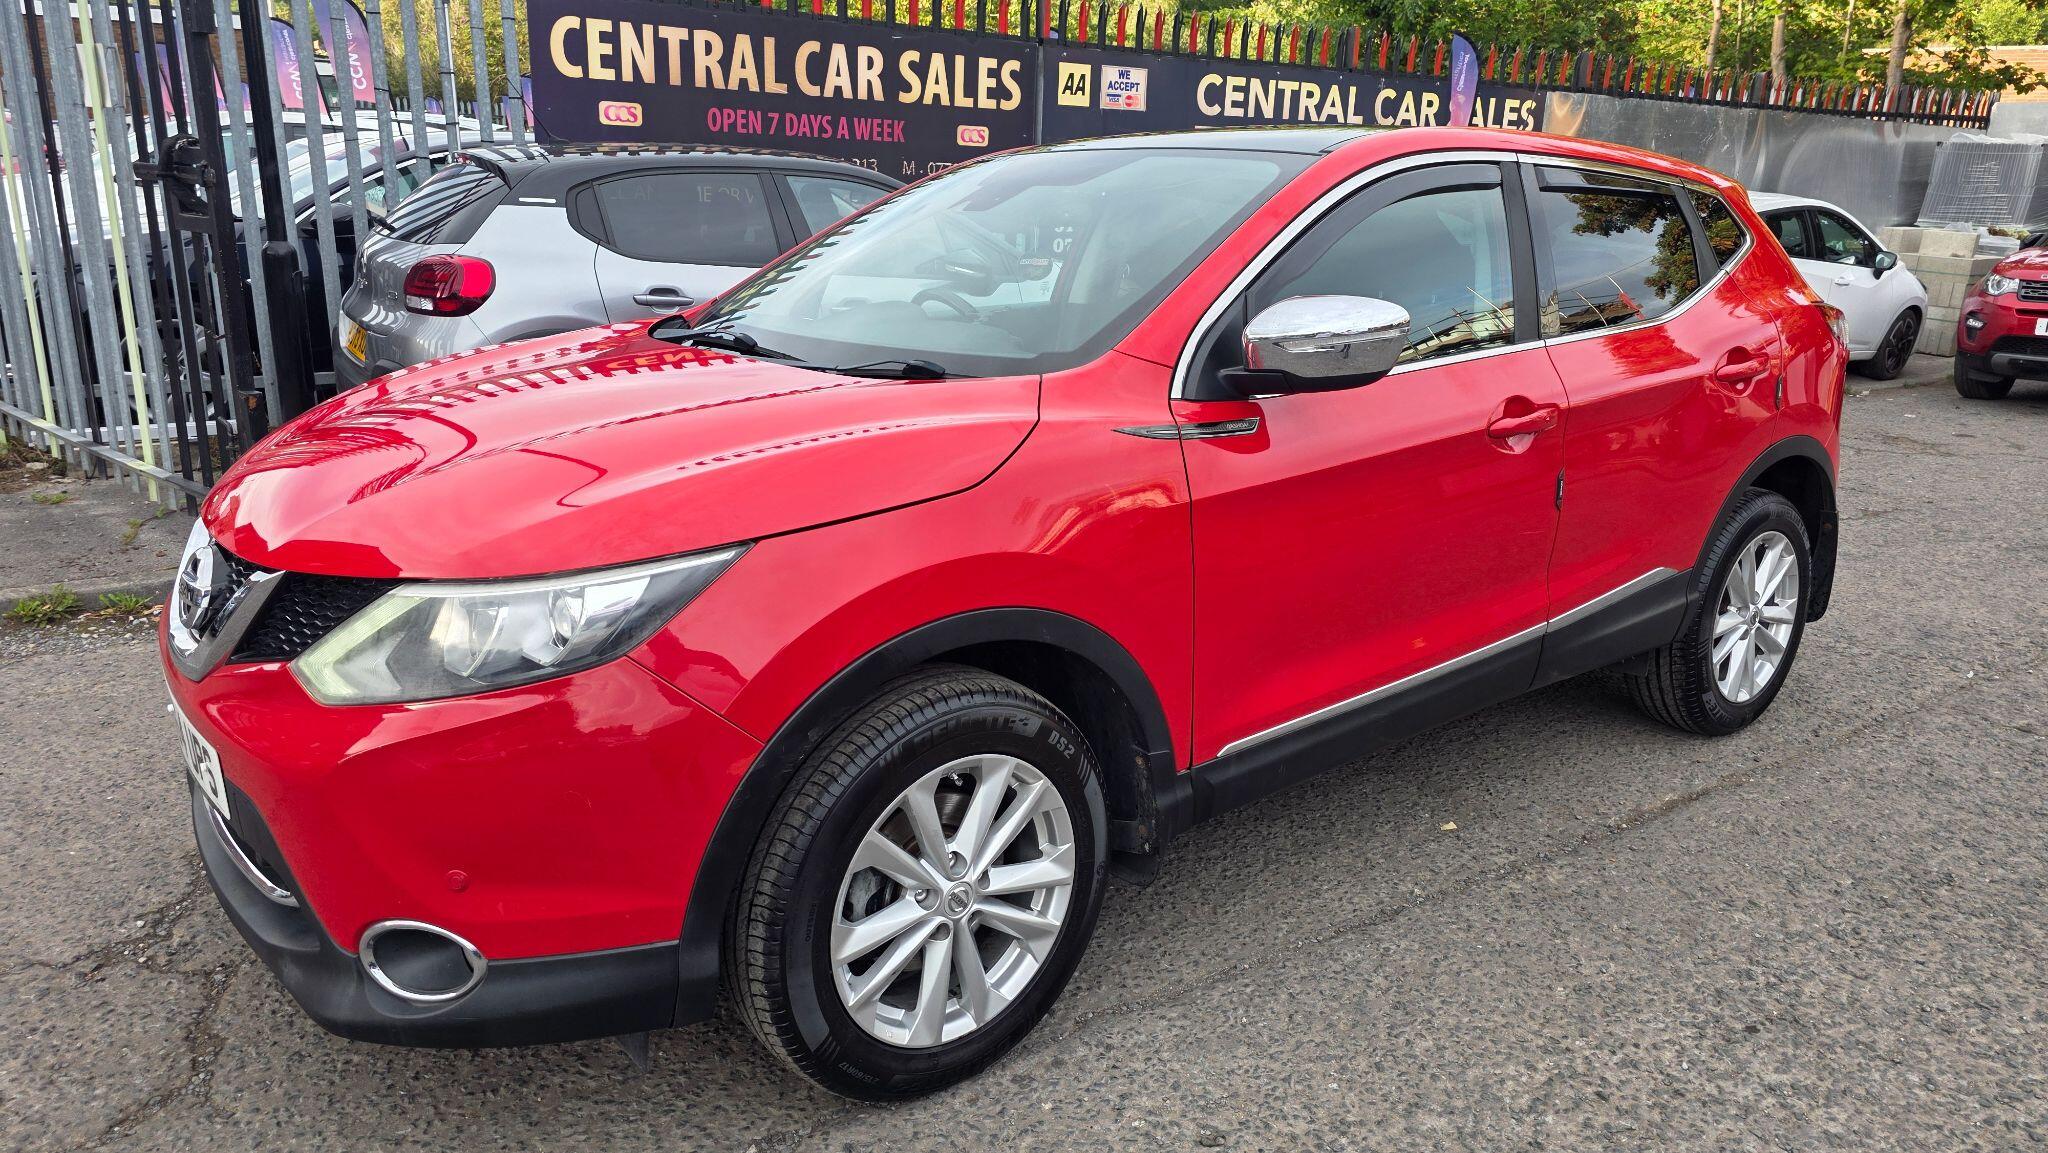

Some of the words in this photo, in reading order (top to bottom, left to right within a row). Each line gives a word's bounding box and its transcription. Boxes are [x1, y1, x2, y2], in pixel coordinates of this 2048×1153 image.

[550, 16, 788, 94] CENTRAL
[795, 41, 884, 101] CAR
[899, 50, 1022, 111] SALES
[1118, 69, 1131, 80] WE
[1061, 72, 1086, 96] AA
[1107, 80, 1140, 92] ACCEPT
[1197, 73, 1364, 124] CENTRAL
[1375, 88, 1440, 127] CAR
[1446, 96, 1537, 131] ALES
[707, 107, 762, 136] OPEN
[767, 112, 780, 135] 7
[785, 114, 832, 139] DAYS
[837, 116, 849, 139] A
[854, 117, 905, 142] WEEK
[1047, 730, 1075, 759] DS2
